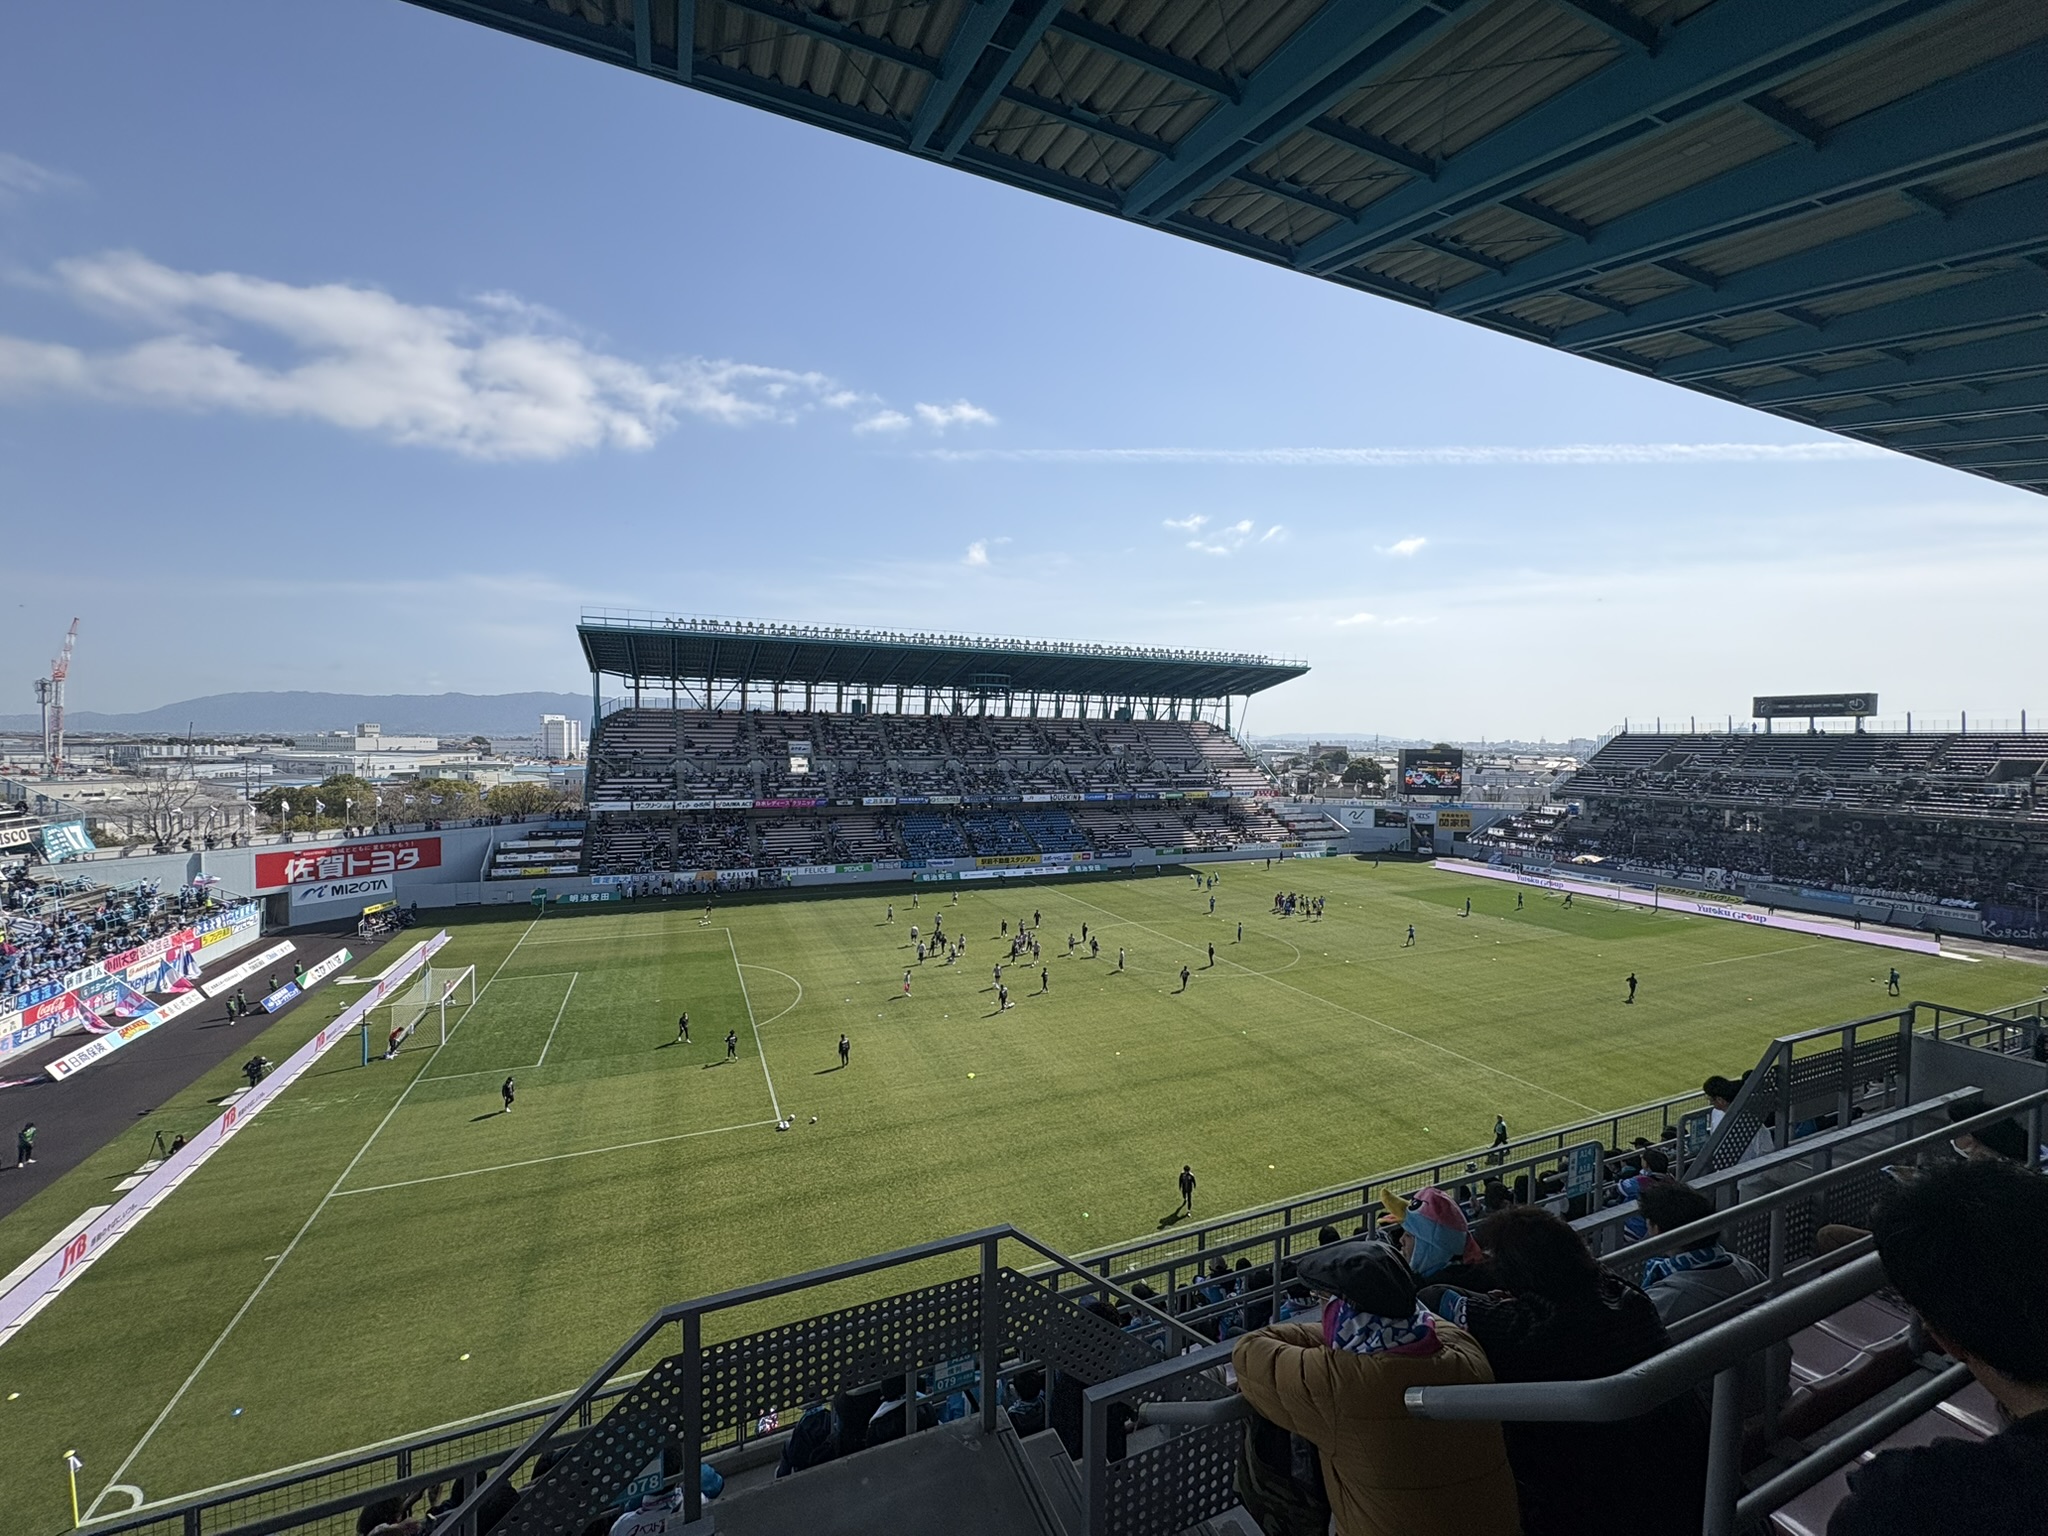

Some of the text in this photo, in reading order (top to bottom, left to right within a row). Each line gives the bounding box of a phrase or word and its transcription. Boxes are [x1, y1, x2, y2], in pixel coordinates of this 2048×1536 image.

[284, 848, 419, 884] 佐賀トヨタ
[804, 866, 828, 874] FELICE
[331, 879, 388, 896] MIZOTA
[569, 892, 610, 902] 明治安田
[1697, 904, 1767, 924] Yutoku Group
[937, 1376, 957, 1390] 079
[627, 1475, 660, 1496] 078
